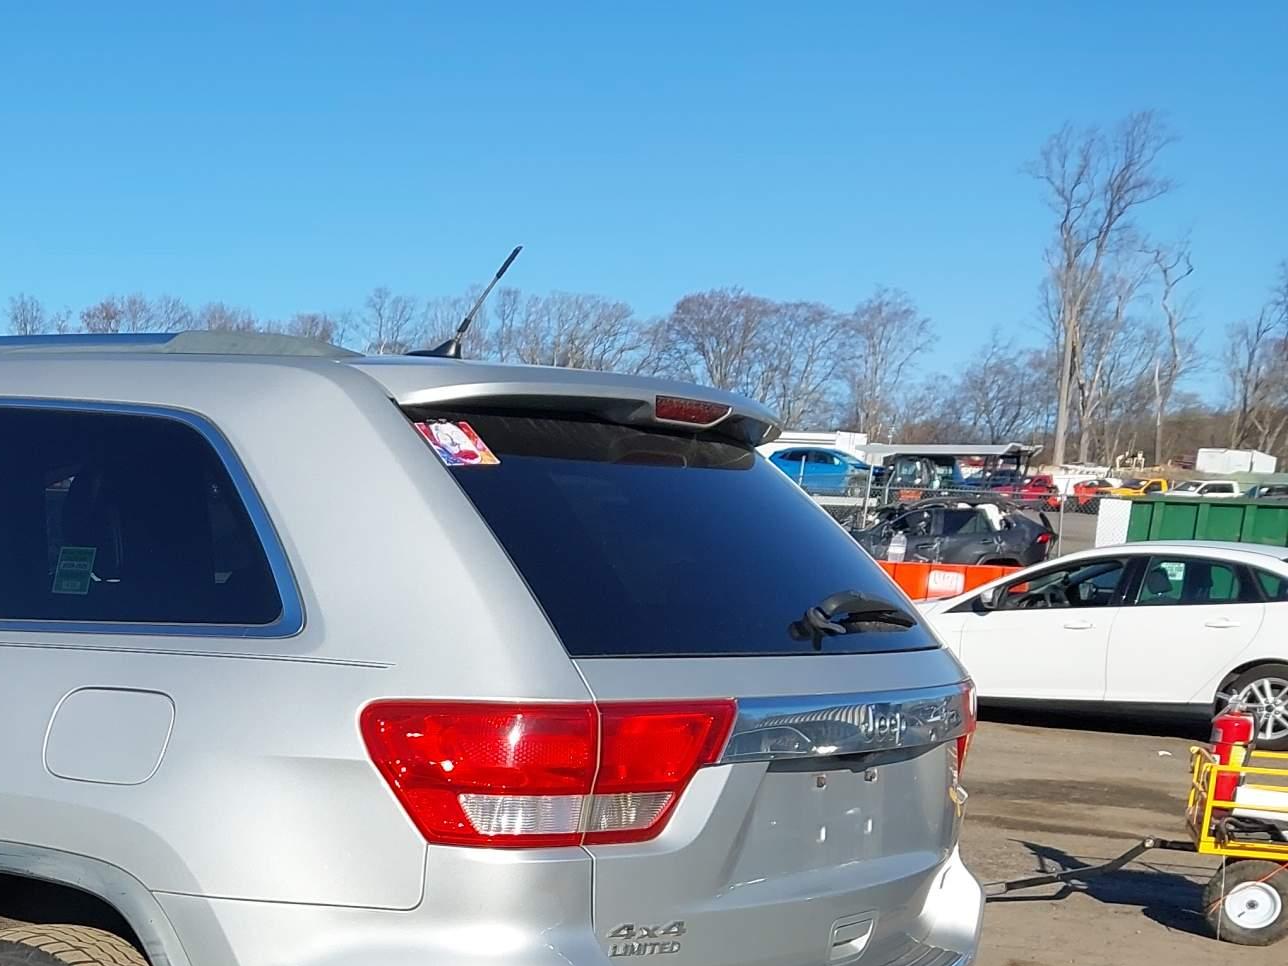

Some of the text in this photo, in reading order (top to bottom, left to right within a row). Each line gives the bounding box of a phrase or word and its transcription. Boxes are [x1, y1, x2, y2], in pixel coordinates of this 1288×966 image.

[861, 703, 907, 747] Jeep
[607, 920, 687, 939] 4x4
[608, 941, 681, 957] LIMITED
